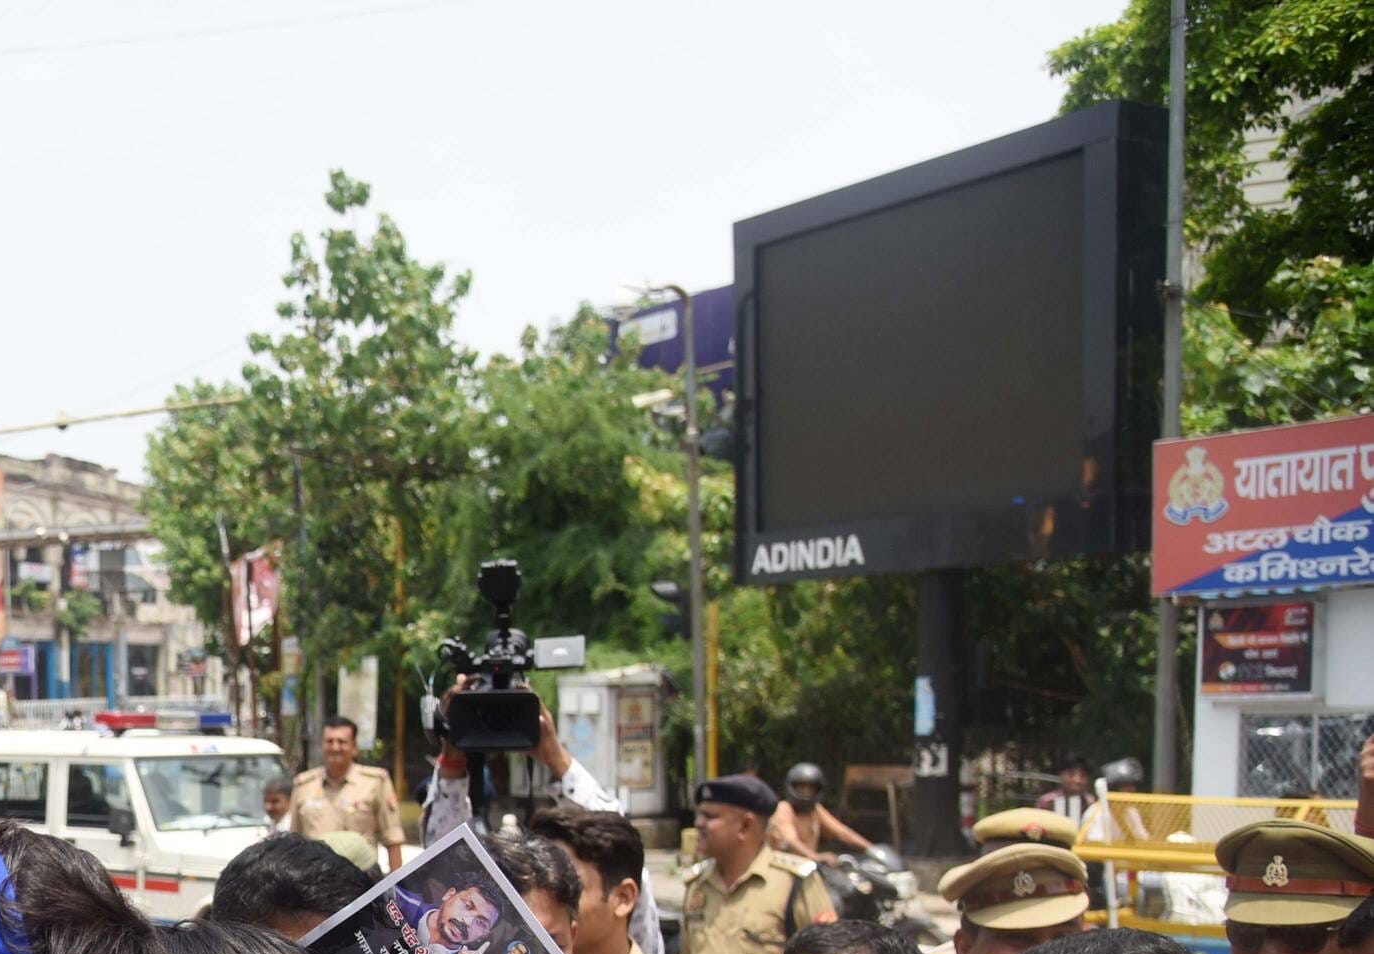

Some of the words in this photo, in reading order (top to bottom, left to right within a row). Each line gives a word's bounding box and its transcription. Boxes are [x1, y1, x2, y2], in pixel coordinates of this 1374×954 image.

[1234, 447, 1358, 500] यातायात
[750, 533, 866, 576] ADINDIA
[1202, 526, 1291, 555] अटल
[1290, 514, 1374, 545] चौक
[401, 922, 419, 948] चंद्र
